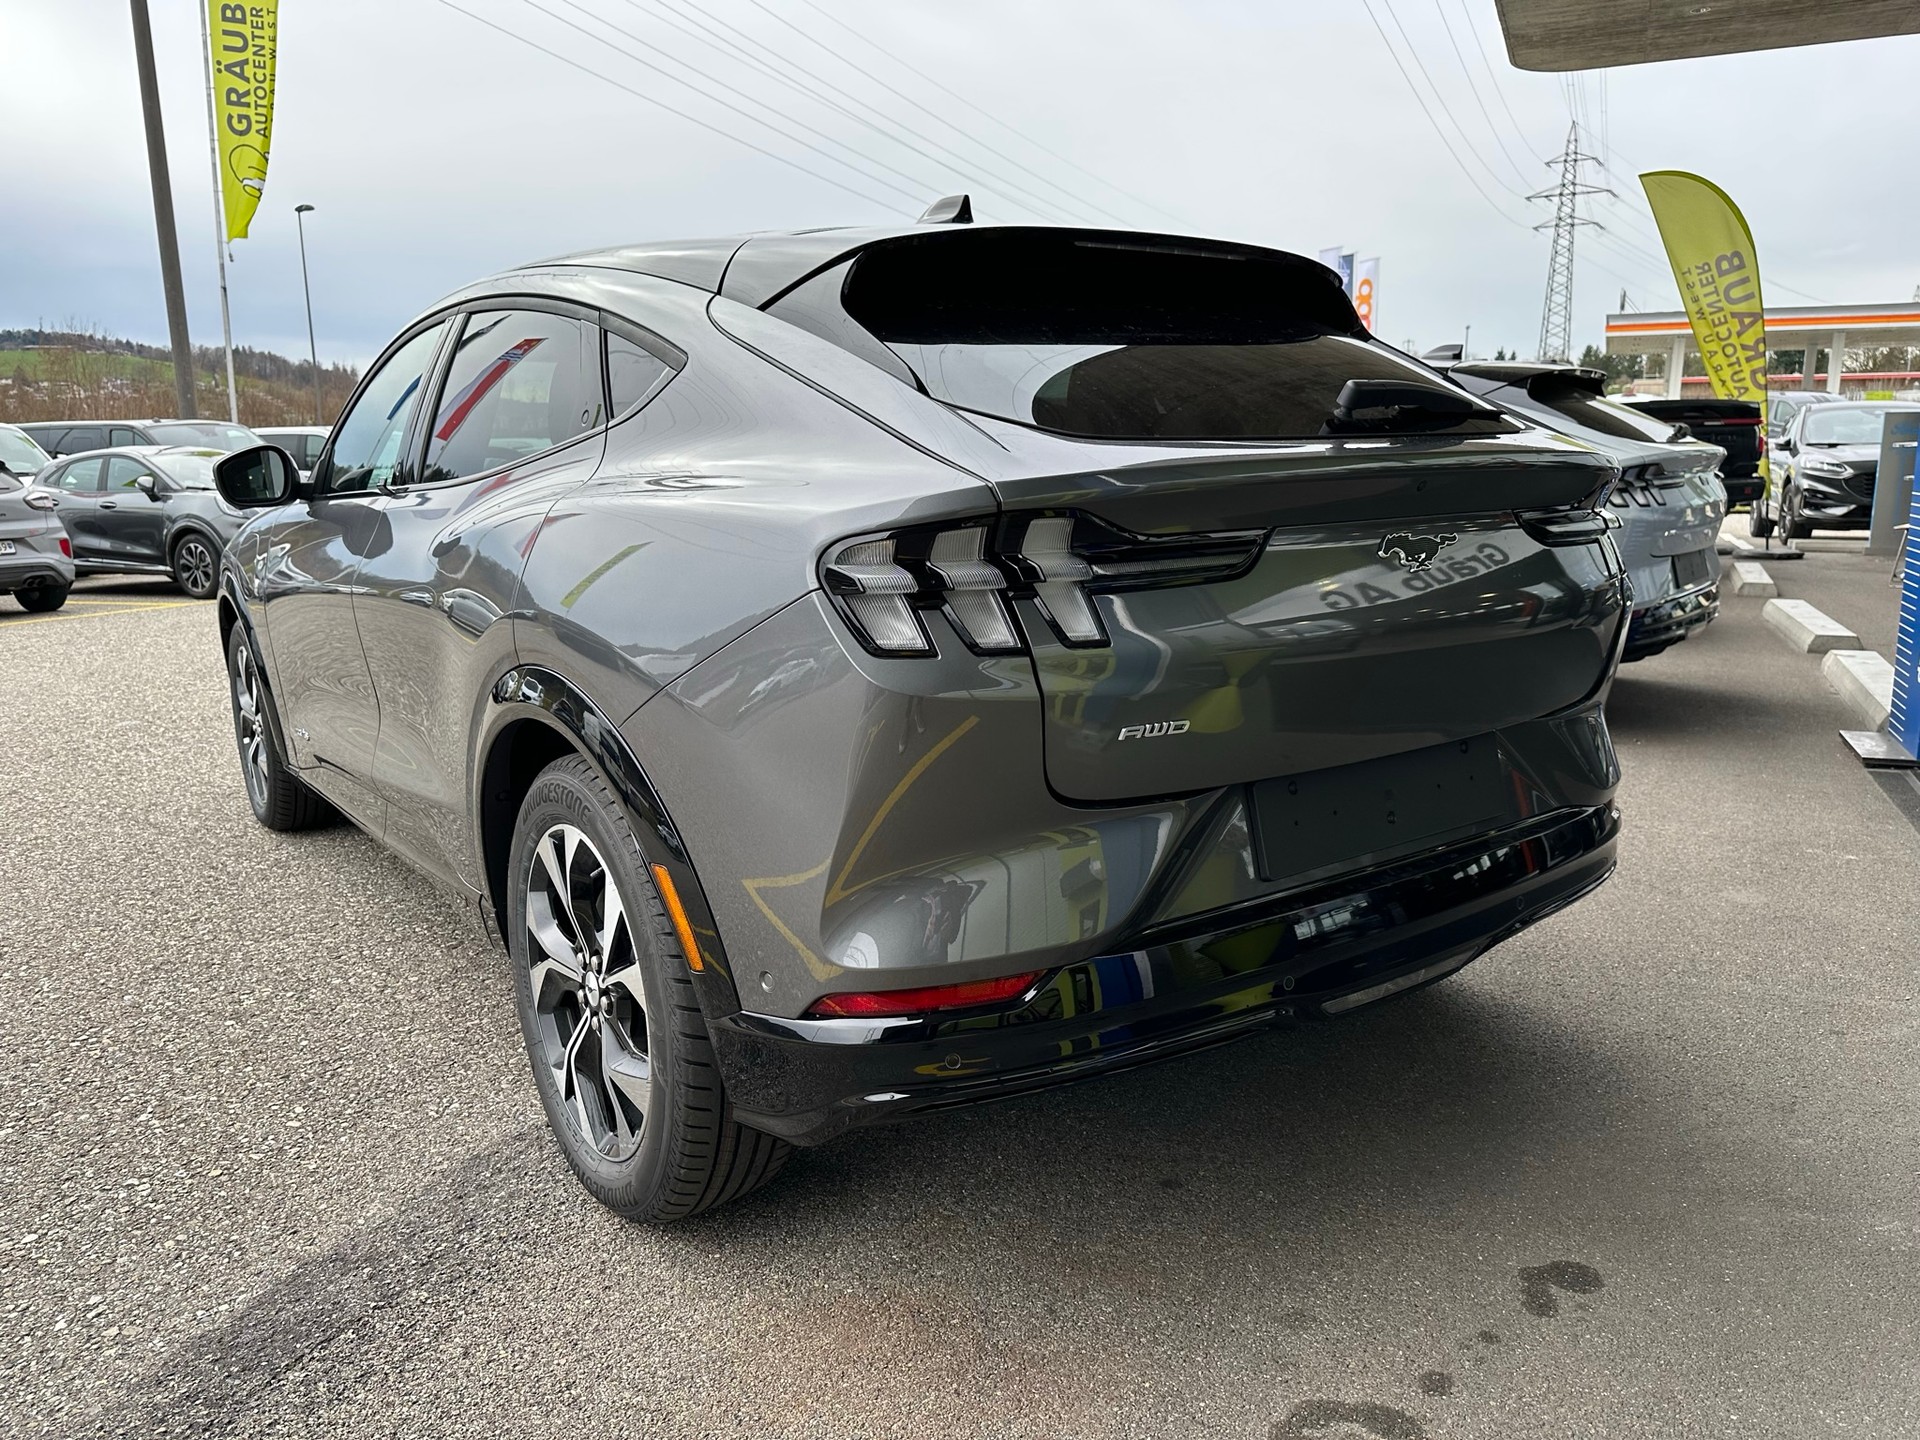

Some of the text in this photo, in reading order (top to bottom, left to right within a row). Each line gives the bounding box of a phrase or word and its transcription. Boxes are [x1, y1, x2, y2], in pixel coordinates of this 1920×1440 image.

[216, 3, 252, 137] GRÄUB
[250, 6, 269, 139] AUTOCENTER
[1118, 720, 1190, 740] AWD
